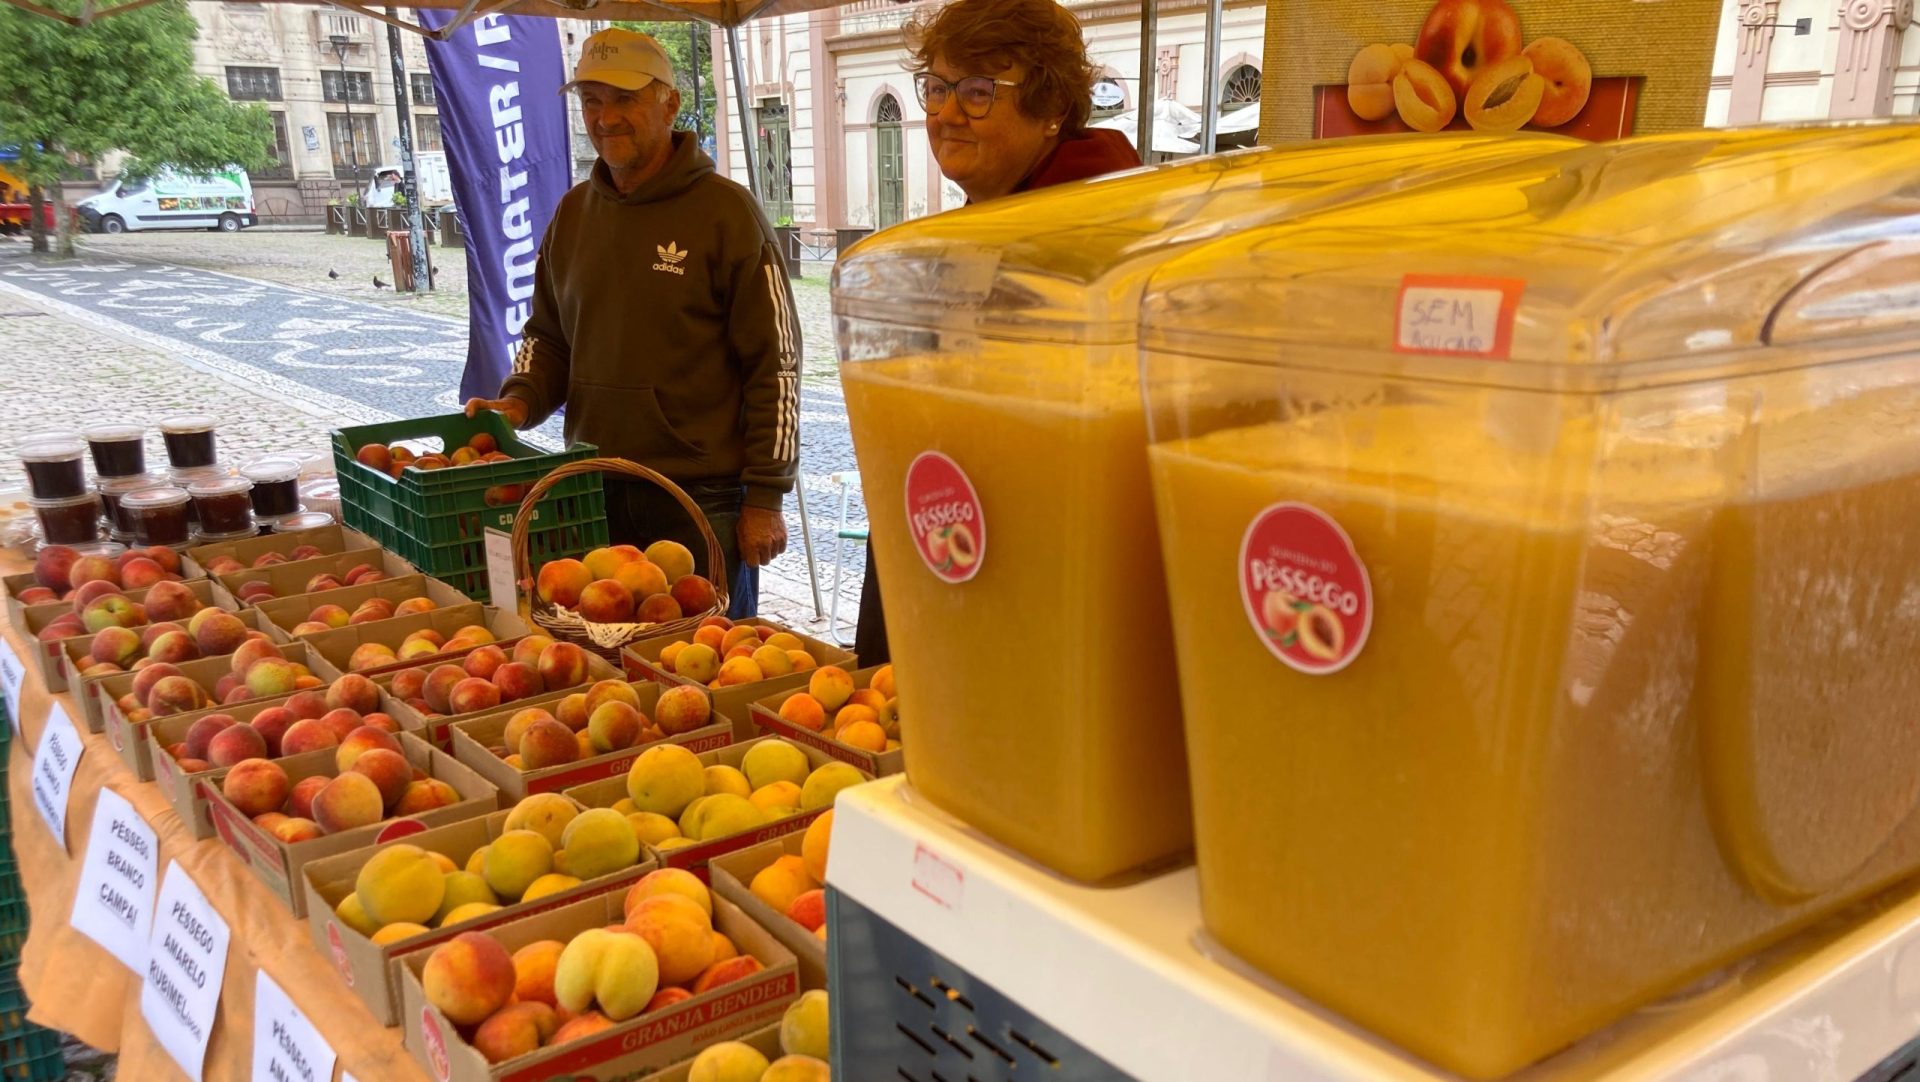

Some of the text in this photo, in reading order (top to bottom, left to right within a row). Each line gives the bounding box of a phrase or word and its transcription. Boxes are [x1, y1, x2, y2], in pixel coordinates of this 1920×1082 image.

[653, 262, 685, 276] adidas
[1408, 297, 1474, 332] SEM
[107, 849, 145, 890] BRANCO
[163, 932, 207, 990] AMARELO
[622, 1008, 704, 1051] GRANJA
[709, 976, 788, 1019] BENDER
